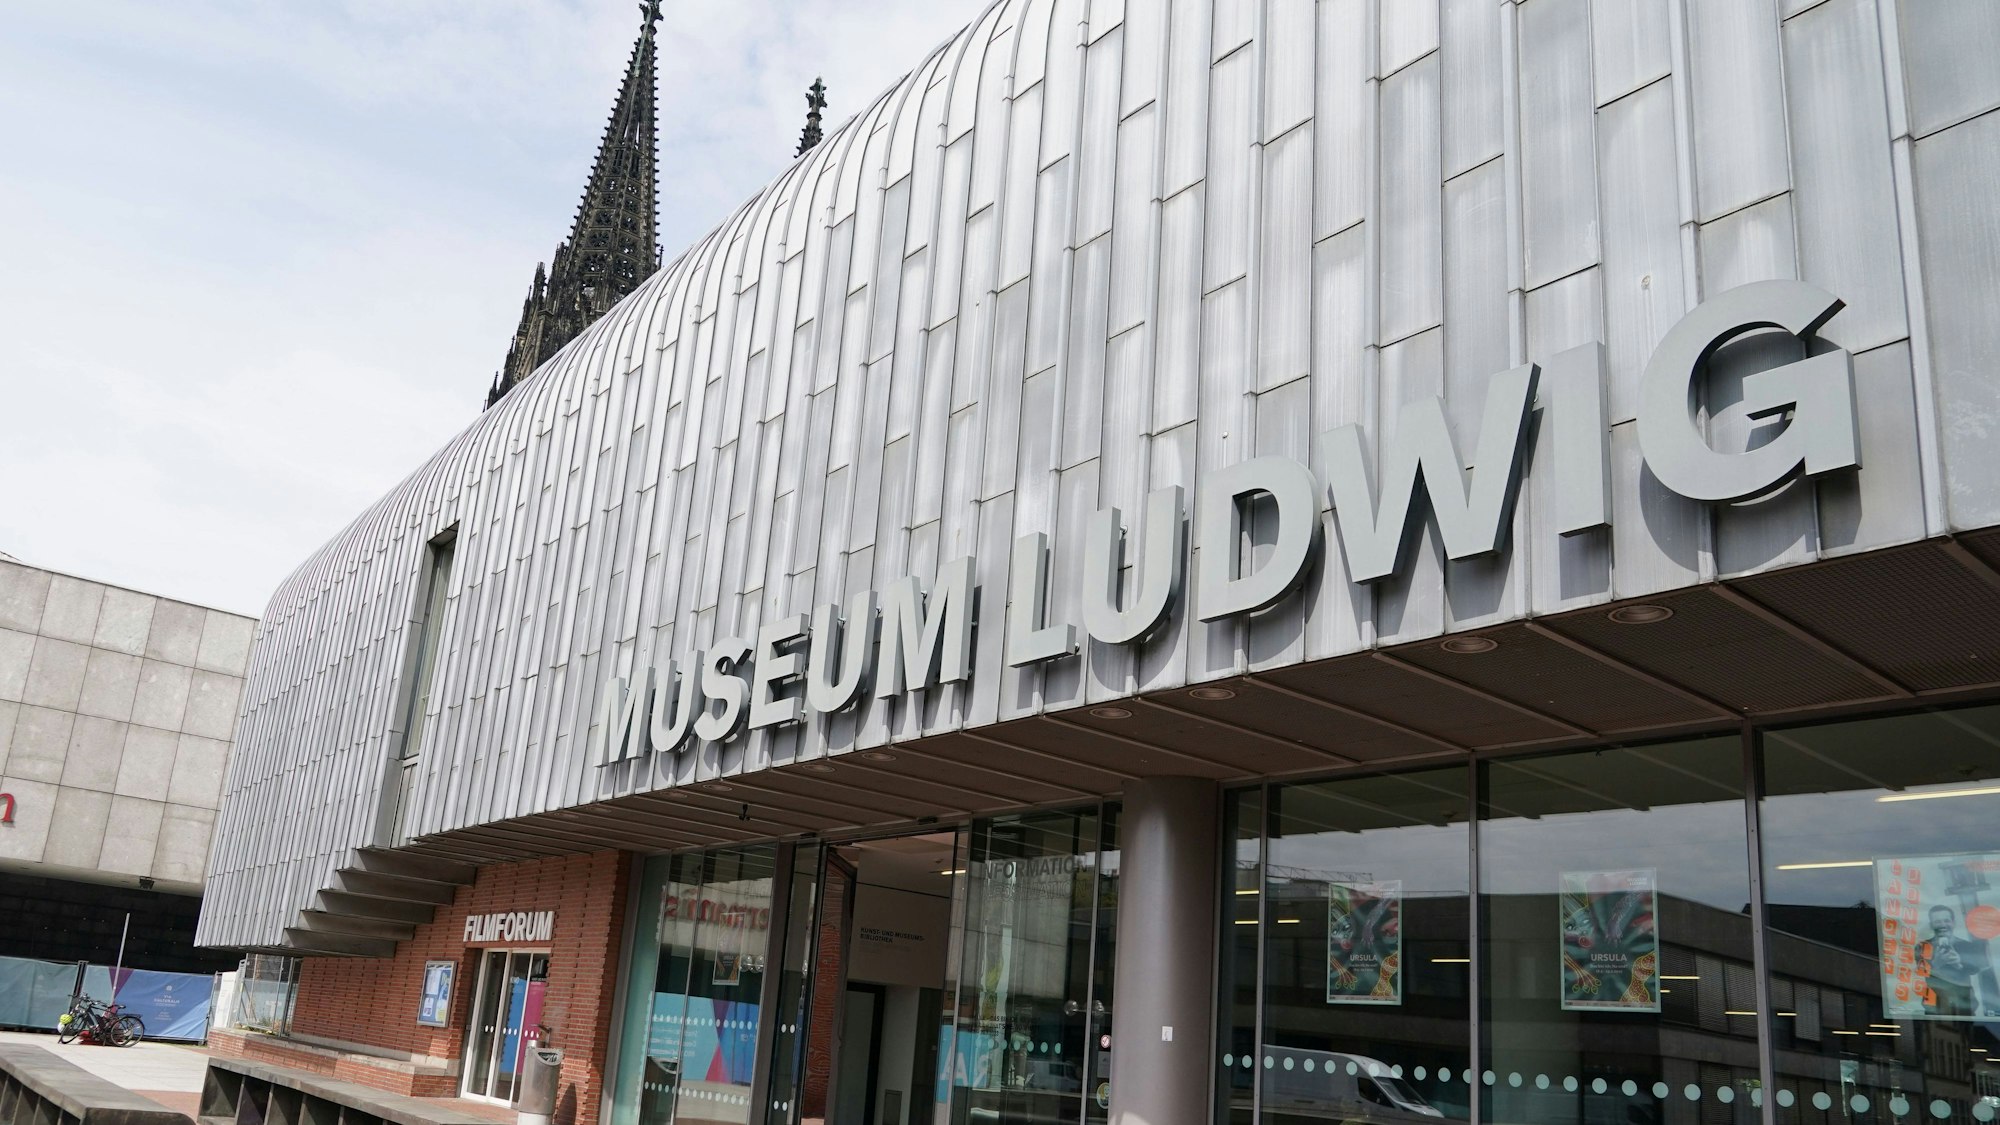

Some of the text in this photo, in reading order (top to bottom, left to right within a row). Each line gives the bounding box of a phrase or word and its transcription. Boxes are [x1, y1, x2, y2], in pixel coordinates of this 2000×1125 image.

[594, 279, 1863, 768] MUSEUM LUDWIG
[463, 911, 555, 942] FILMFORUM
[1349, 954, 1378, 962] URSULA
[1590, 953, 1628, 962] URSULA
